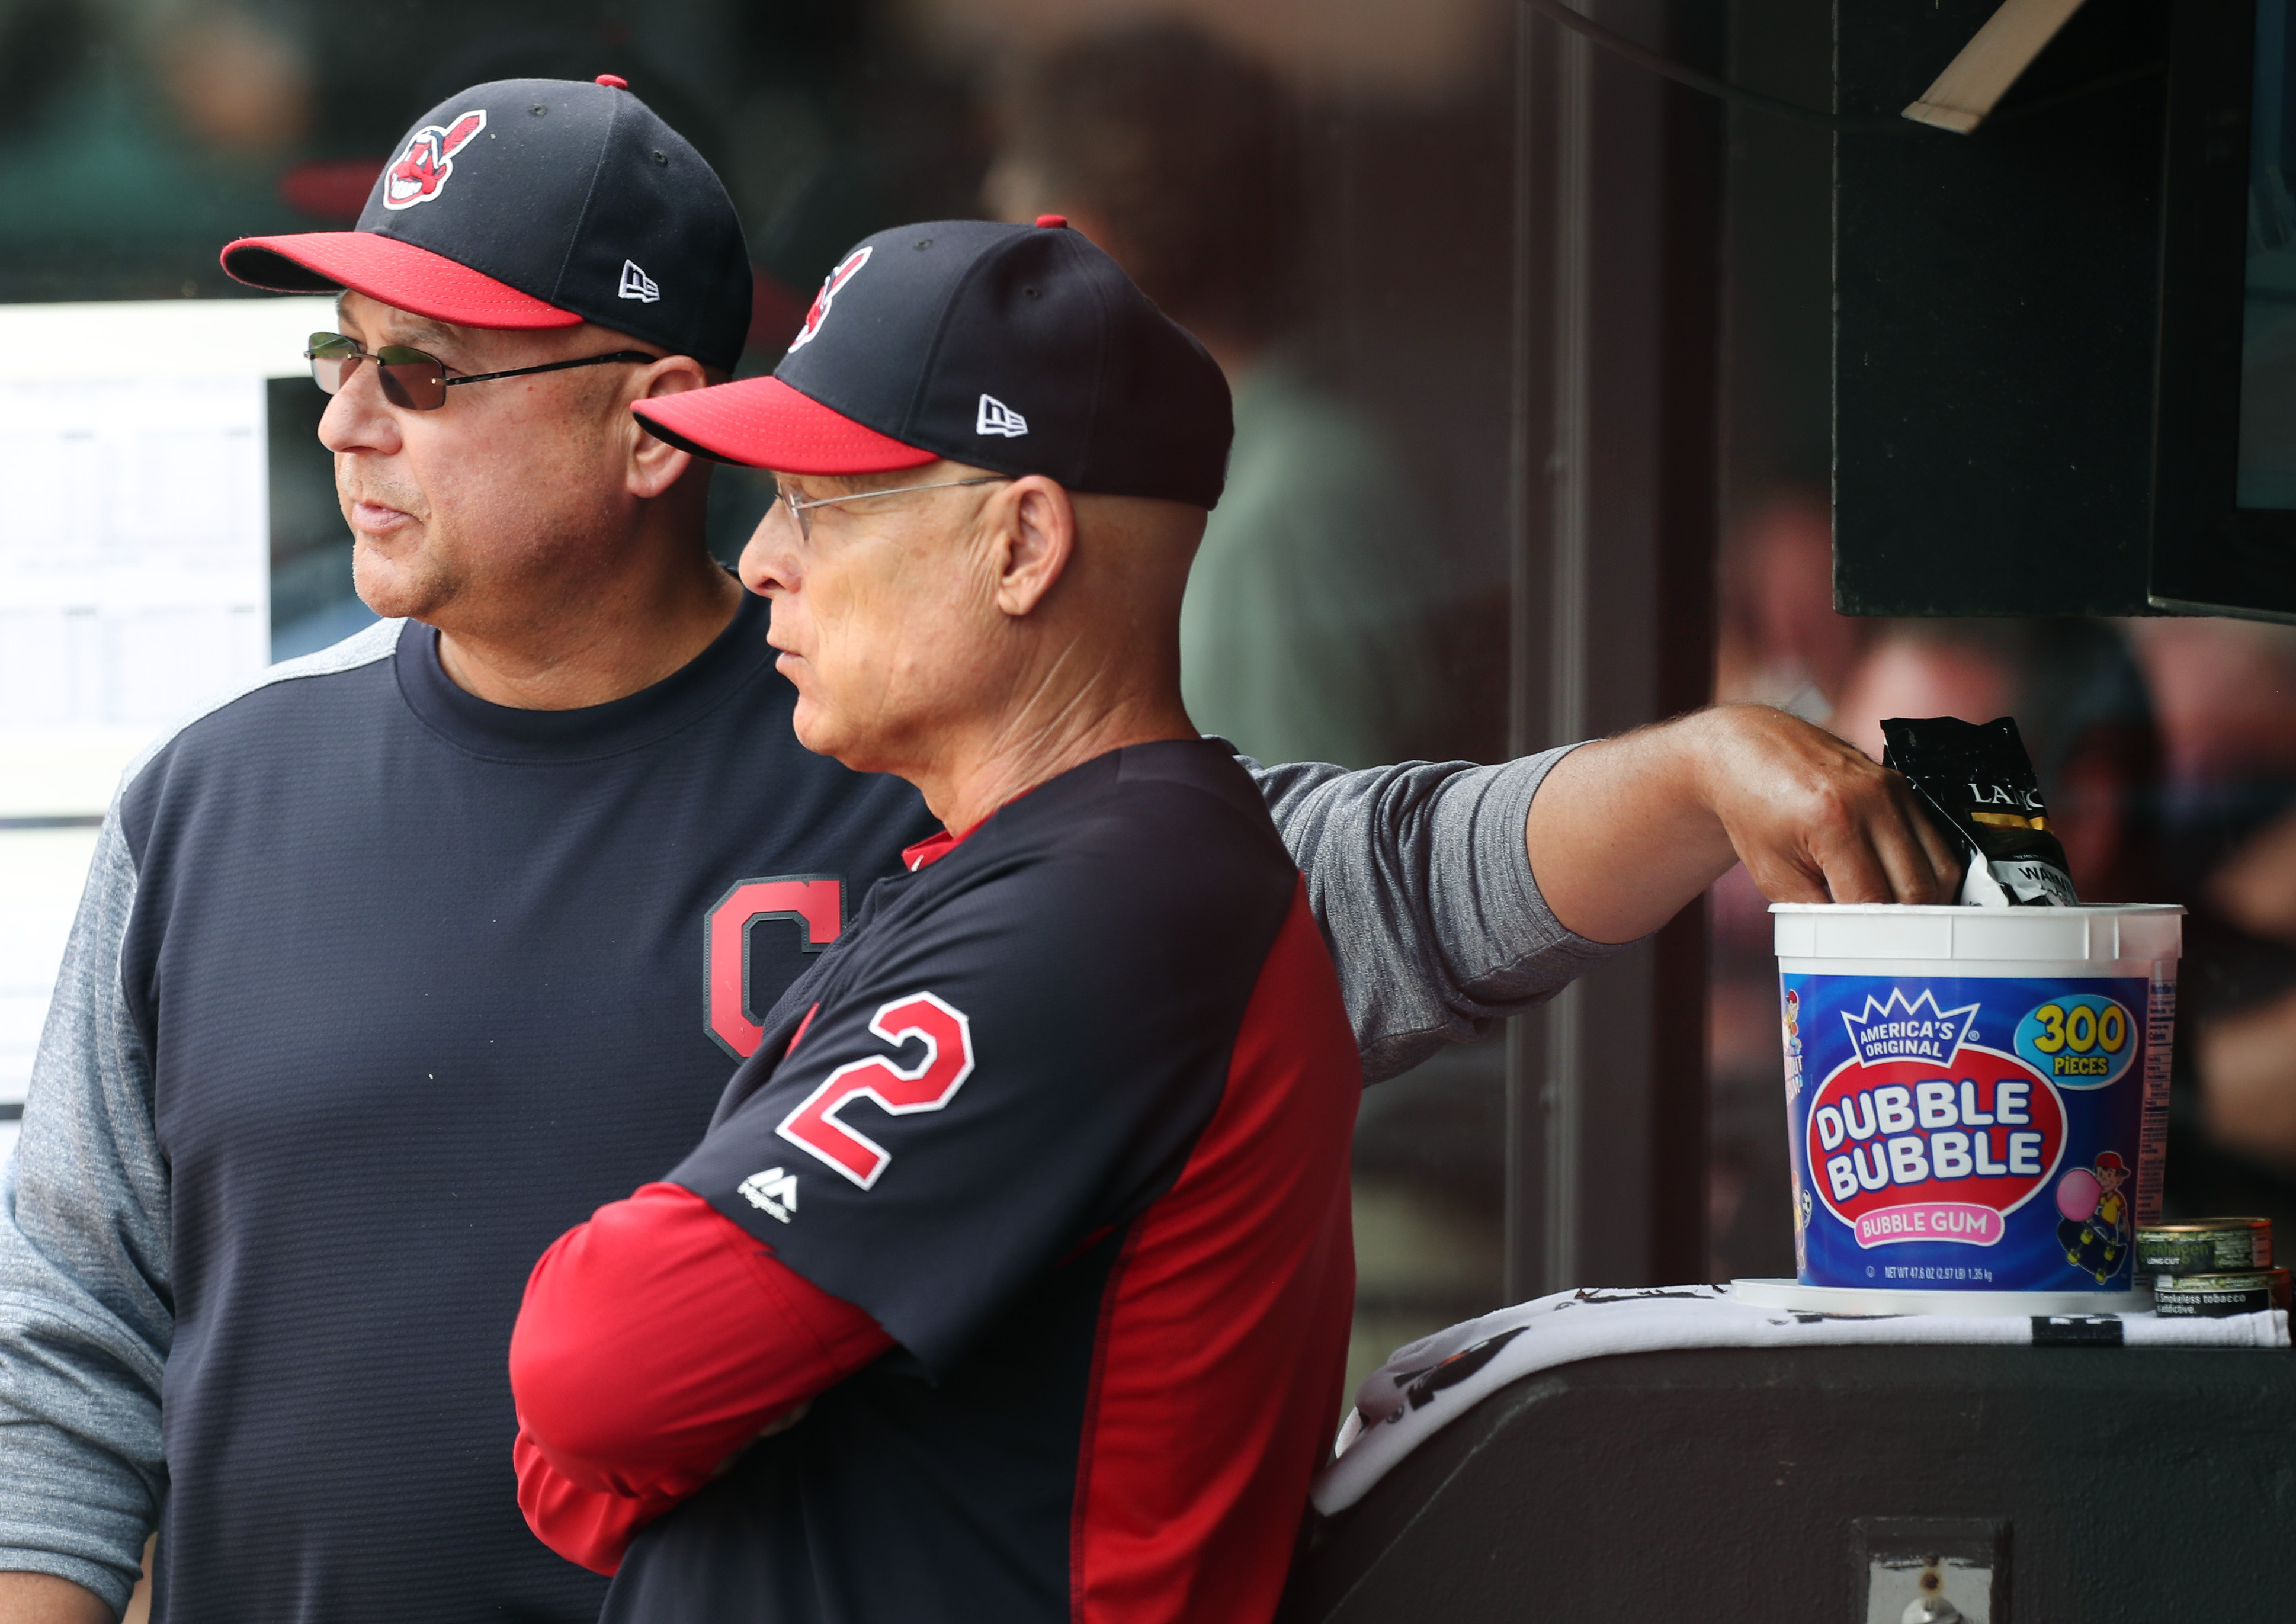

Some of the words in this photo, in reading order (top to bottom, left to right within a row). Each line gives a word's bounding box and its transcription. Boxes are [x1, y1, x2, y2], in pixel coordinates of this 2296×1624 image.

[704, 874, 846, 1065] C
[1859, 1020, 1955, 1045] AMERICA'S
[2033, 1004, 2127, 1053] 300
[1865, 1039, 1943, 1058] ORIGINAL
[775, 991, 976, 1192] 2
[1815, 1081, 2031, 1151] DUBBLE
[1826, 1131, 2042, 1202] BUBBLE
[1862, 1212, 1926, 1238] BUBBLE
[1930, 1211, 1988, 1235] GUM
[1885, 1266, 1896, 1279] NET
[1897, 1266, 1909, 1279] WT
[1910, 1266, 1925, 1279] 47.6
[1926, 1267, 1935, 1279] OZ
[1936, 1267, 1954, 1280] (2.97
[1968, 1267, 1983, 1280] 1.35
[2160, 1292, 2201, 1304] Smokeless
[2202, 1293, 2247, 1304] tobacco
